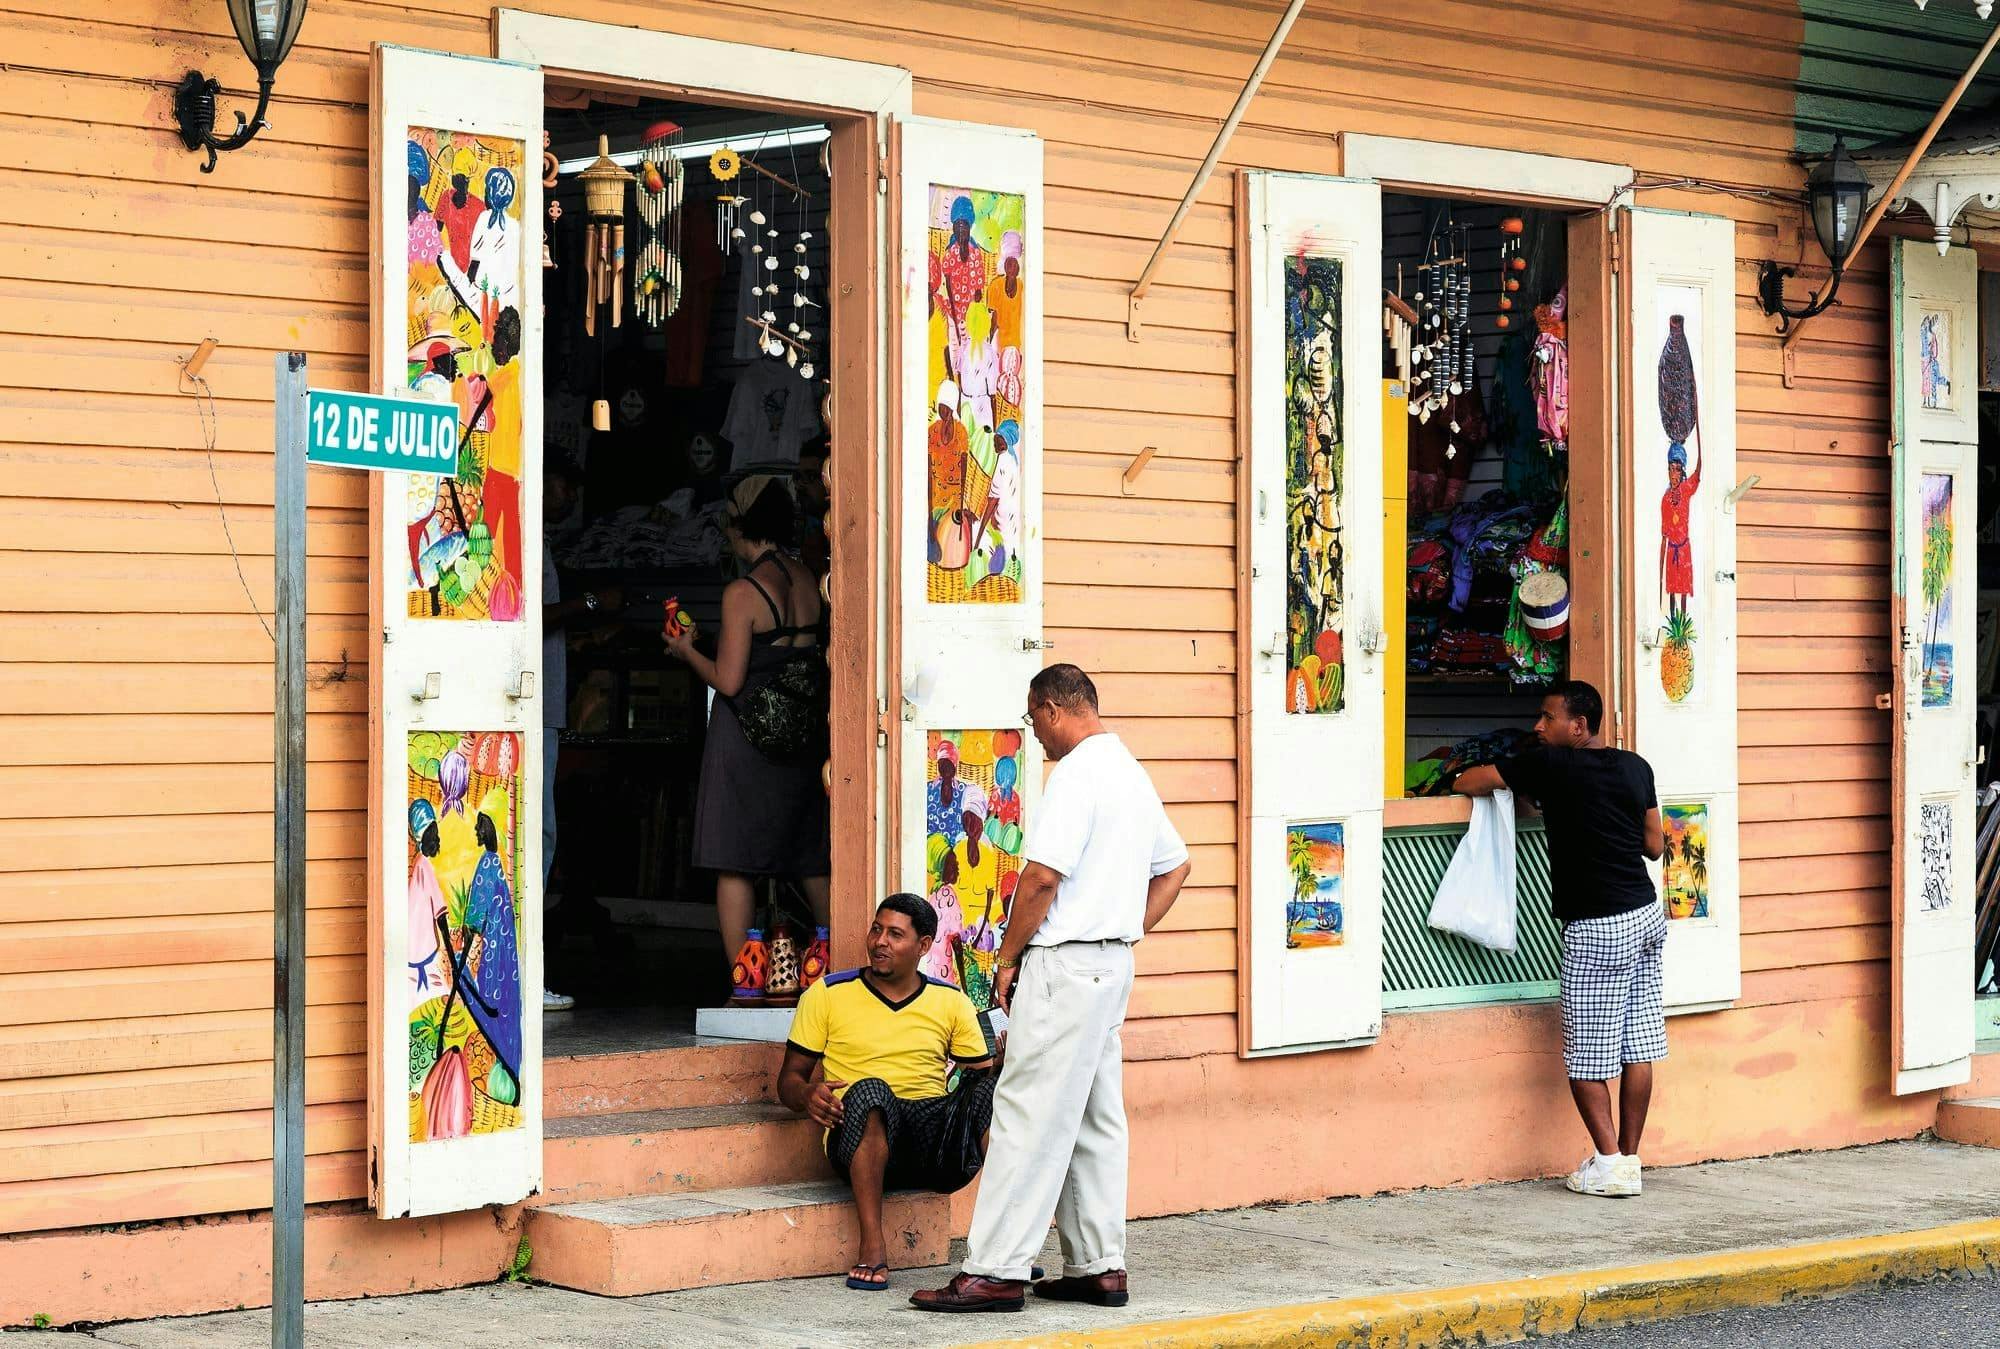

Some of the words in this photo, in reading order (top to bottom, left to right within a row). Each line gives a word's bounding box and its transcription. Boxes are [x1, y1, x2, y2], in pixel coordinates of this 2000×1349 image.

[313, 401, 340, 448] 12
[347, 405, 380, 452] DE
[385, 410, 455, 460] JULIO
